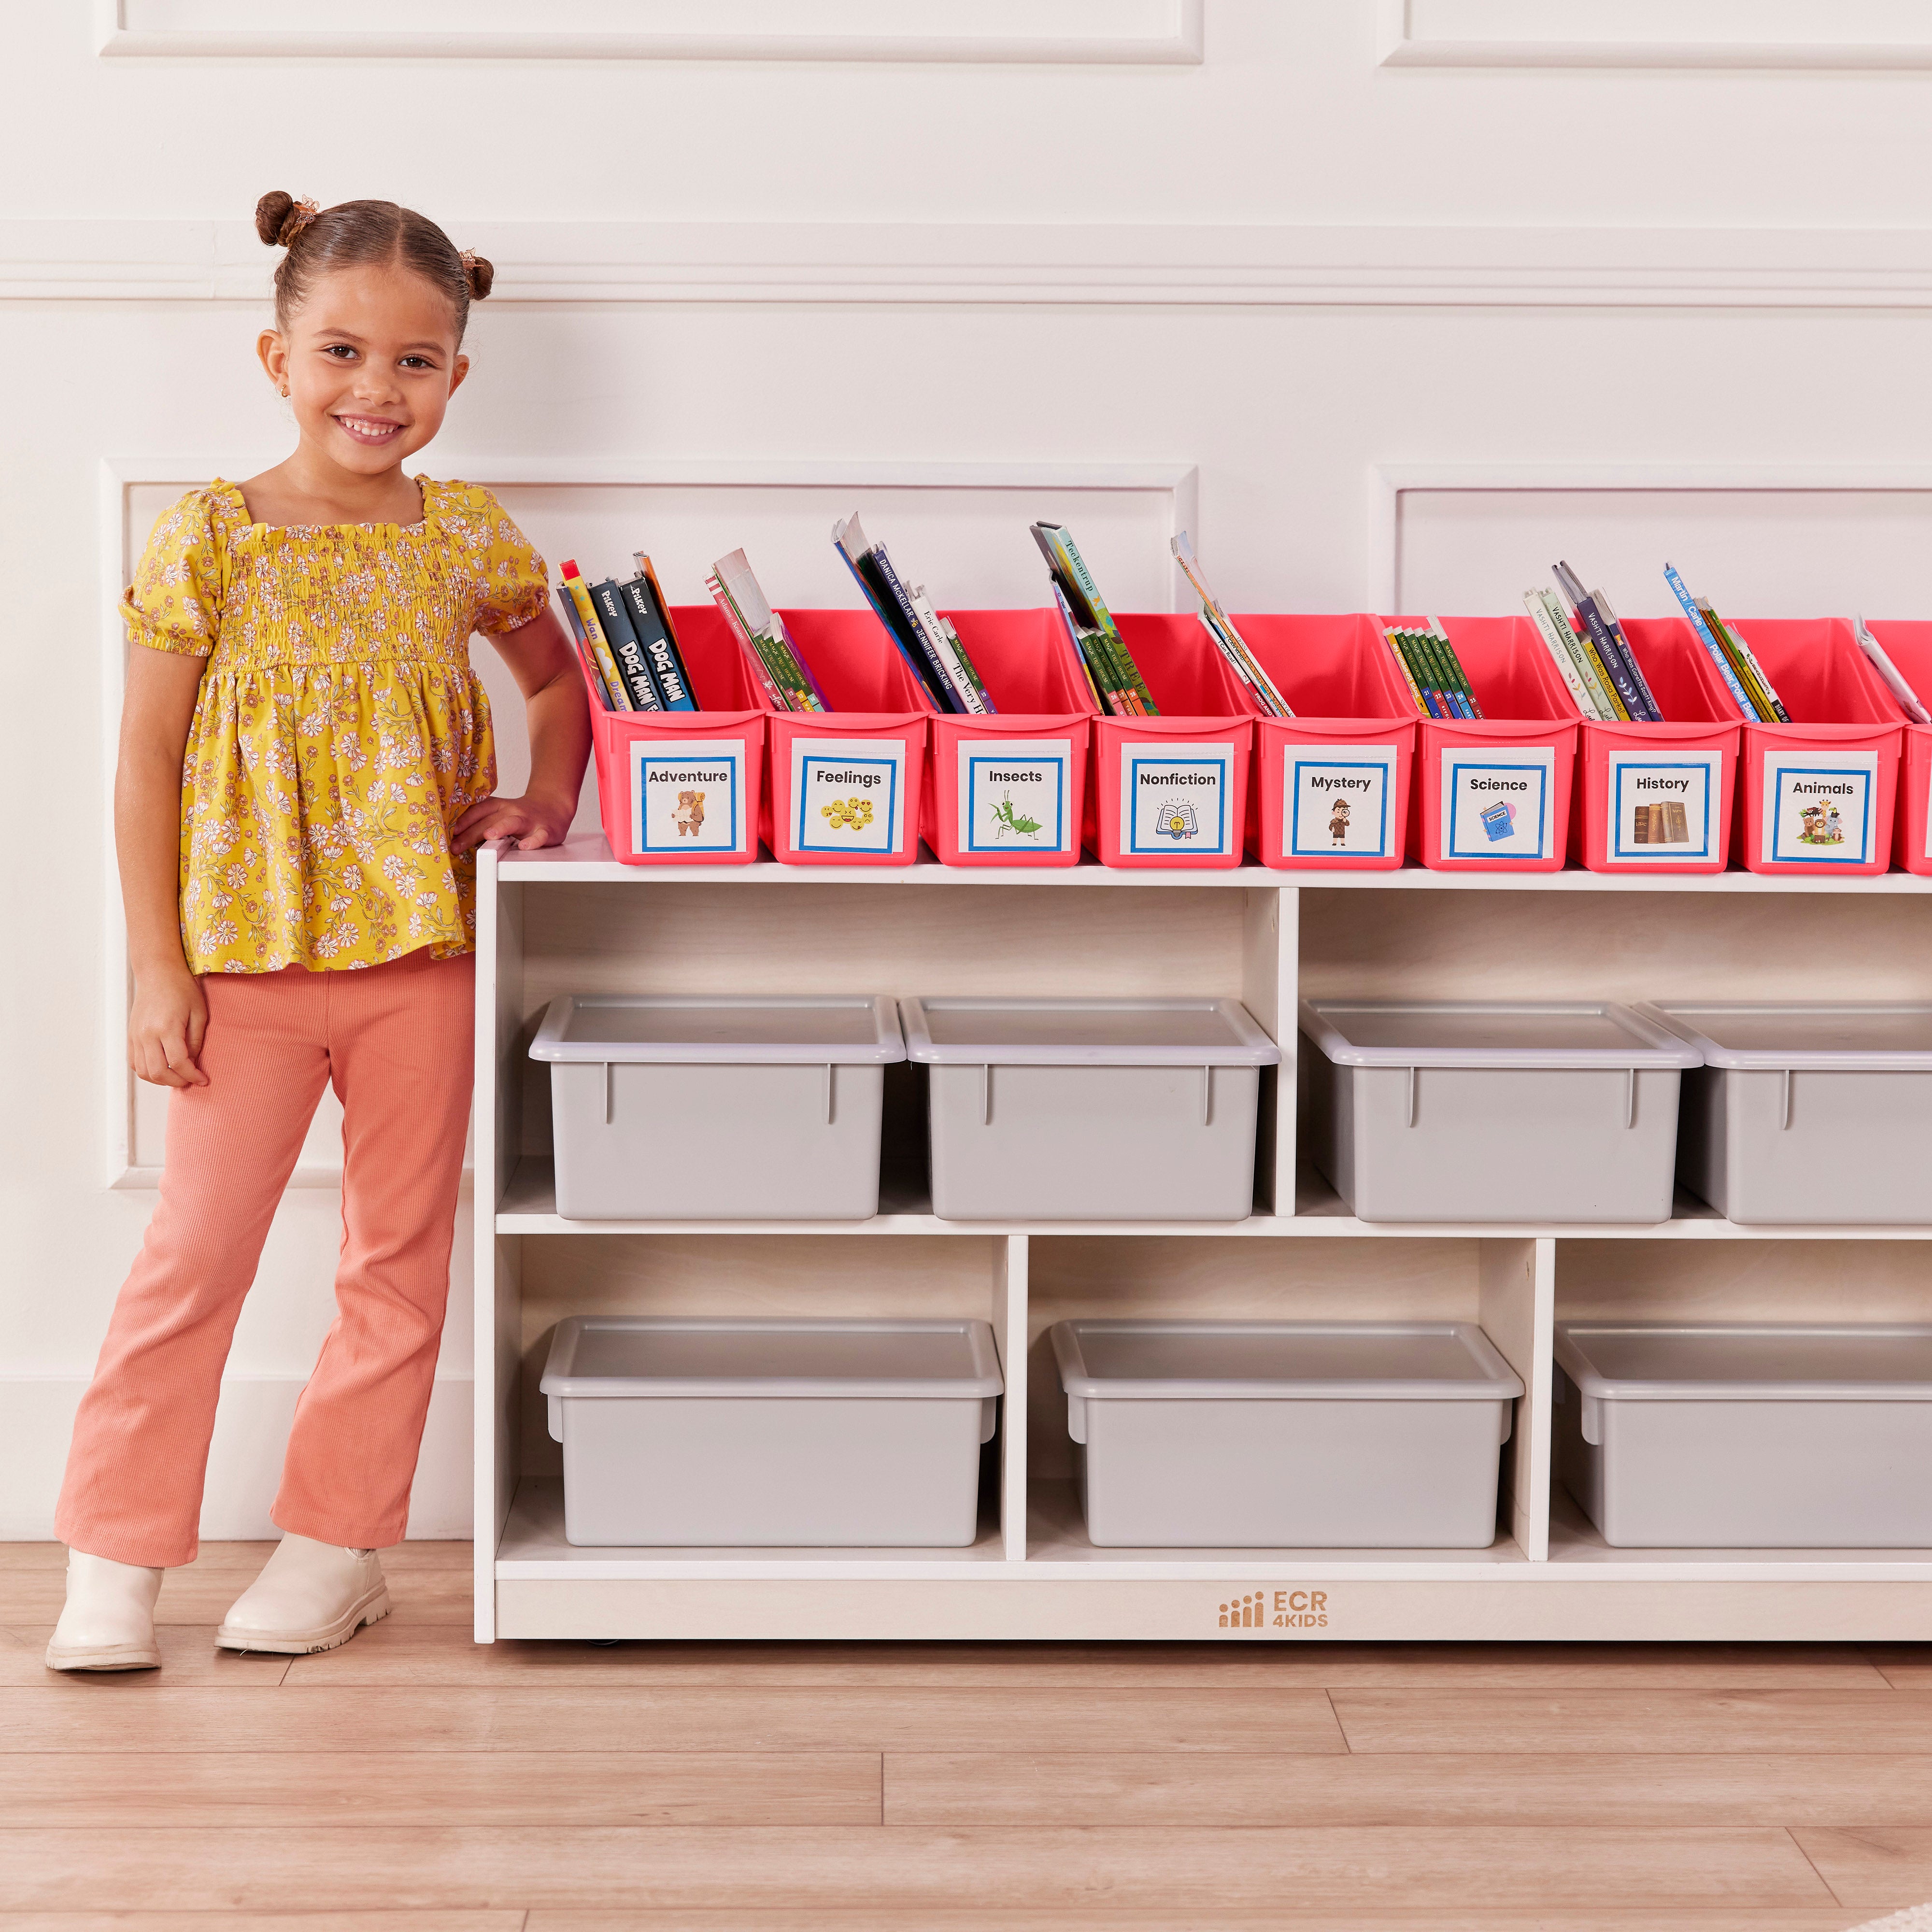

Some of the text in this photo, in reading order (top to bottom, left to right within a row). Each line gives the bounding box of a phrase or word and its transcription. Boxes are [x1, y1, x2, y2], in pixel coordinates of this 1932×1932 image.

[879, 559, 896, 583] DANICA
[1065, 540, 1094, 591] Teckentrup
[719, 598, 744, 639] Adams Keane
[1671, 576, 1689, 602] Martin
[1688, 606, 1702, 626] Carle
[586, 618, 598, 639] Wan
[923, 611, 943, 644] Eric Carle
[1236, 637, 1248, 651] LIONNI
[1392, 643, 1399, 652] My
[1536, 608, 1566, 664] VASHTI HARRISON
[1552, 606, 1583, 663] VASHTI HARRISON
[1588, 612, 1619, 668] VASHTI HARRISON
[619, 640, 644, 675] DOG
[648, 638, 685, 702] DOG MAN
[759, 639, 785, 681] MAGIC TREE HOUSE
[769, 641, 795, 683] MAGIC TREE HOUSE
[780, 645, 807, 687] MAGIC TREE HOUSE
[916, 629, 952, 690] JENNIFER BRICKING
[953, 639, 979, 682] MAGIC TREE HOUSE
[1085, 641, 1108, 684] MAGIC TREE HOUSE
[1094, 639, 1116, 682] MAGIC TREE HOUSE
[1103, 639, 1127, 681] MAGIC TREE HOUSE
[1120, 649, 1146, 692] TREE
[1226, 652, 1236, 665] Read!
[1400, 637, 1409, 652] MAGIC
[1412, 665, 1422, 679] HOUSE
[1411, 639, 1421, 655] MAGIC
[1424, 667, 1434, 683] HOUSE
[1421, 639, 1431, 655] MAGIC
[1434, 668, 1444, 682] HOUSE
[1434, 640, 1443, 655] MAGIC
[1446, 668, 1456, 683] HOUSE
[1445, 645, 1468, 687] MAGIC TREE HOUSE
[1710, 644, 1725, 664] Polar
[1720, 664, 1734, 684] Bear,
[1732, 682, 1747, 702] Polar
[631, 675, 656, 705] MAN
[952, 663, 965, 682] The
[963, 682, 976, 704] Very
[1589, 648, 1625, 714] Who Was Rosa Parks?
[1632, 668, 1642, 687] Coretta
[1640, 687, 1651, 701] Scott
[1647, 701, 1657, 713] King?
[769, 694, 785, 711] Love
[1255, 693, 1272, 716] FROG AND
[1763, 700, 1773, 714] NATIONAL
[1775, 704, 1785, 716] DIARY
[648, 771, 727, 782] Adventure
[816, 770, 881, 788] Feelings
[989, 770, 1042, 782] Insects
[1140, 773, 1216, 785] Nonfiction
[1311, 776, 1372, 792] Mystery
[1470, 779, 1527, 791] Science
[1636, 778, 1689, 792] History
[1793, 781, 1854, 795] Animals
[1489, 811, 1506, 821] SCIENCE
[1273, 1614, 1328, 1627] 4KIDS
[1274, 1591, 1327, 1611] ECR
